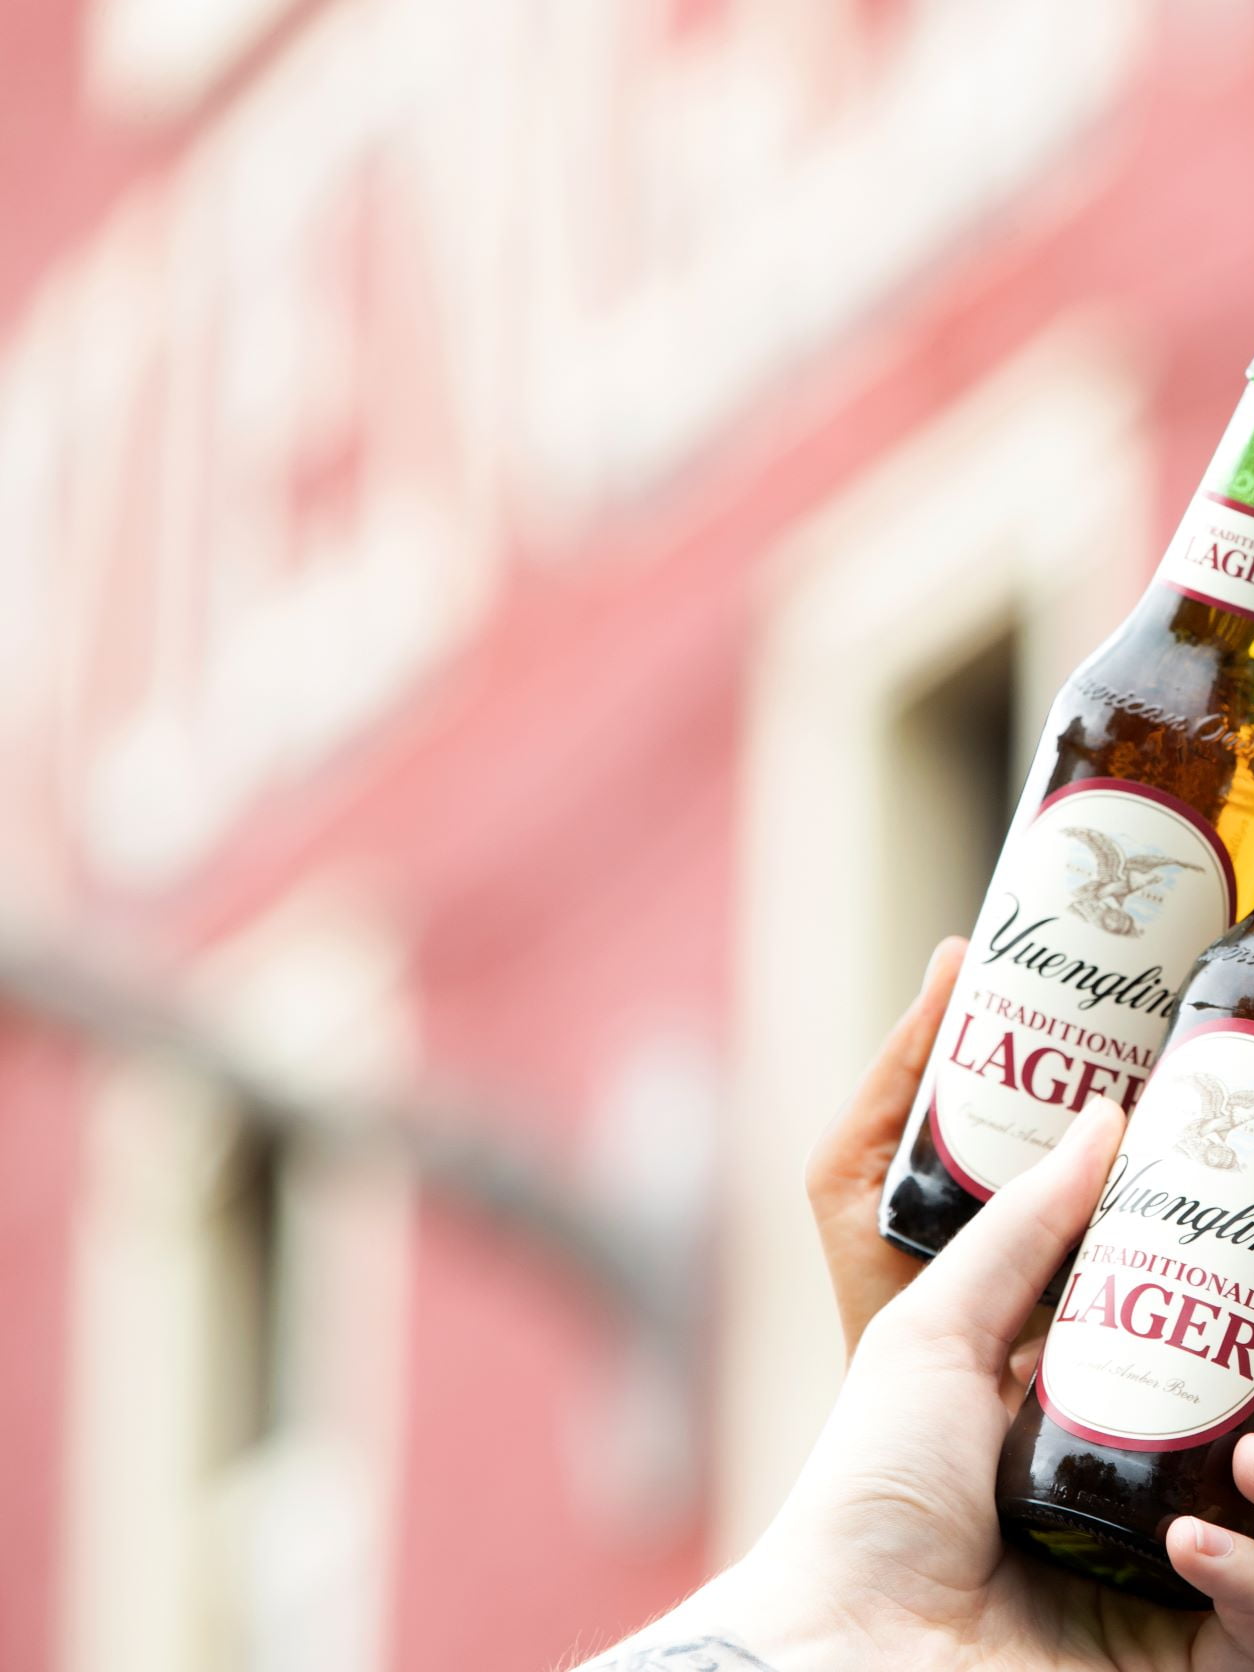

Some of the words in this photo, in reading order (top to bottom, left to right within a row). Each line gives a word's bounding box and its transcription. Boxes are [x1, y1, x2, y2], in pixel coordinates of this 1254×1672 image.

[981, 891, 1179, 1019] Yuenglin
[983, 990, 1154, 1070] TRADITIONAL
[1161, 1377, 1202, 1405] Beer
